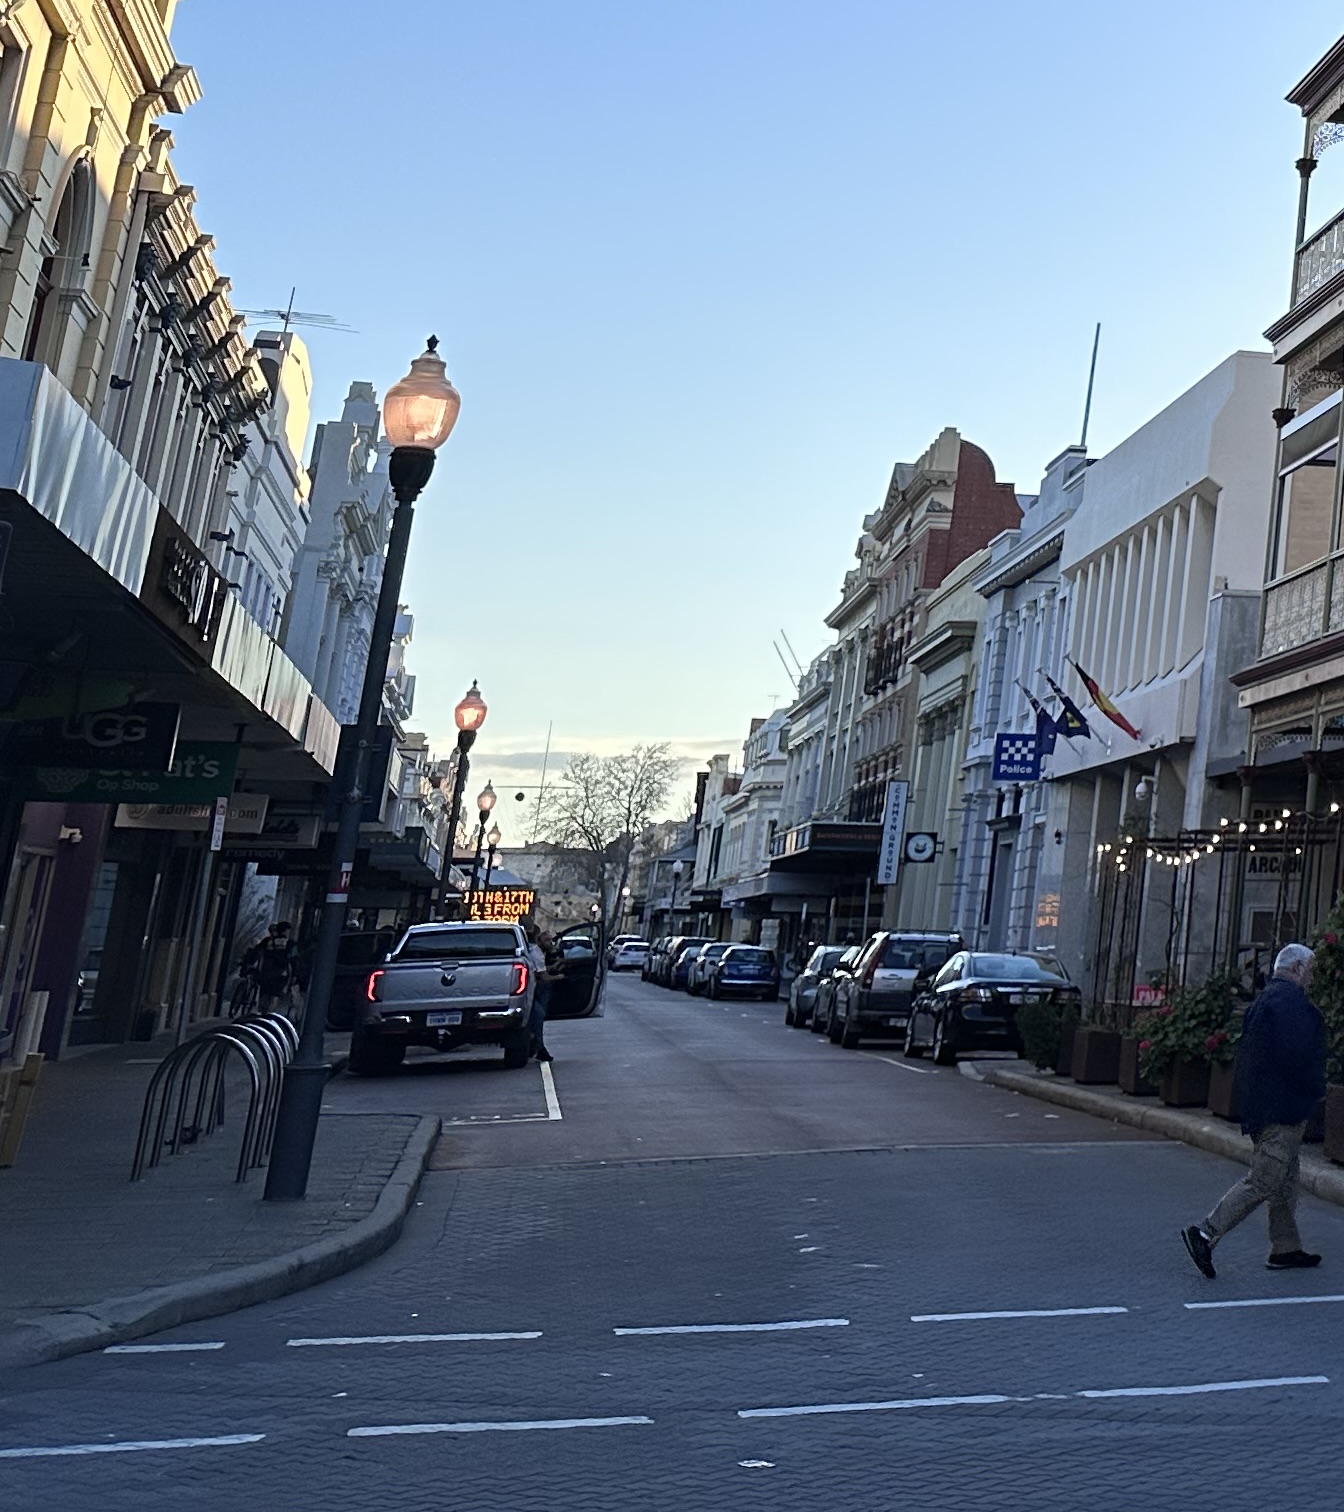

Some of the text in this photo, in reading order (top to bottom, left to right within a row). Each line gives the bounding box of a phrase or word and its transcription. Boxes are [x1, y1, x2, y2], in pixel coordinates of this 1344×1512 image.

[62, 711, 149, 748] UGG
[163, 753, 220, 779] at's
[1000, 764, 1033, 774] Police
[96, 778, 159, 792] Op Shop
[156, 804, 258, 819] adultsh.com
[494, 903, 530, 915] FROM
